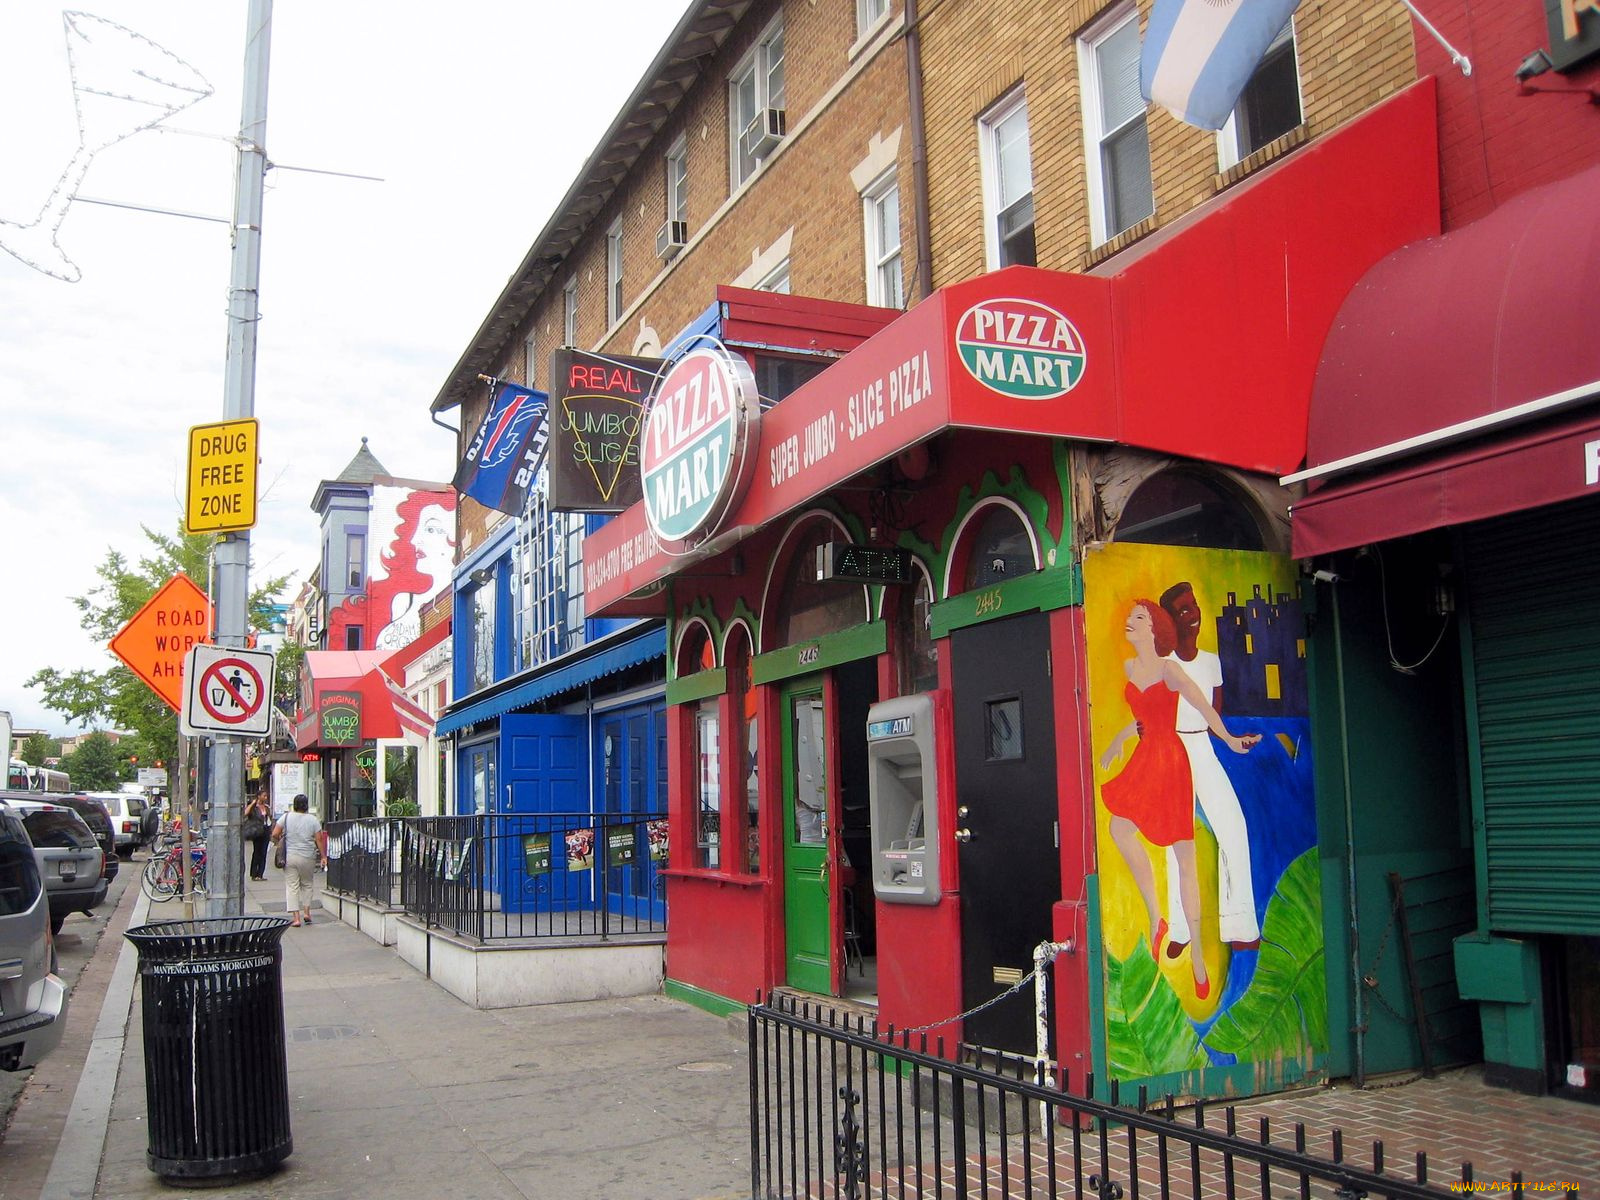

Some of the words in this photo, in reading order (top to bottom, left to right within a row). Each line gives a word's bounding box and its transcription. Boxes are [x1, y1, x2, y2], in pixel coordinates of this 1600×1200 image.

[974, 308, 1076, 351] PIZZA
[569, 365, 641, 393] REAL
[976, 349, 1073, 390] MART
[560, 410, 640, 437] JUMBO
[652, 360, 725, 461] PIZZA
[770, 434, 799, 489] SUPER
[803, 409, 836, 469] JUMBO
[848, 378, 884, 441] SLICE
[889, 350, 932, 417] PIZZA
[200, 433, 247, 457] DRUG
[573, 441, 639, 466] SLICE
[201, 463, 244, 487] FREE
[654, 434, 723, 526] MART
[200, 493, 241, 517] ZONE
[620, 538, 633, 574] FREE
[840, 549, 901, 579] ATM
[976, 588, 1003, 617] 2445
[157, 610, 205, 626] ROAD
[152, 661, 184, 677] AHE
[322, 716, 359, 728] JUMBO
[324, 729, 355, 740] SLICE
[892, 717, 910, 734] ATM
[153, 964, 190, 975] MANTENGA
[191, 963, 220, 974] ADAMS
[221, 958, 254, 972] MORGAN
